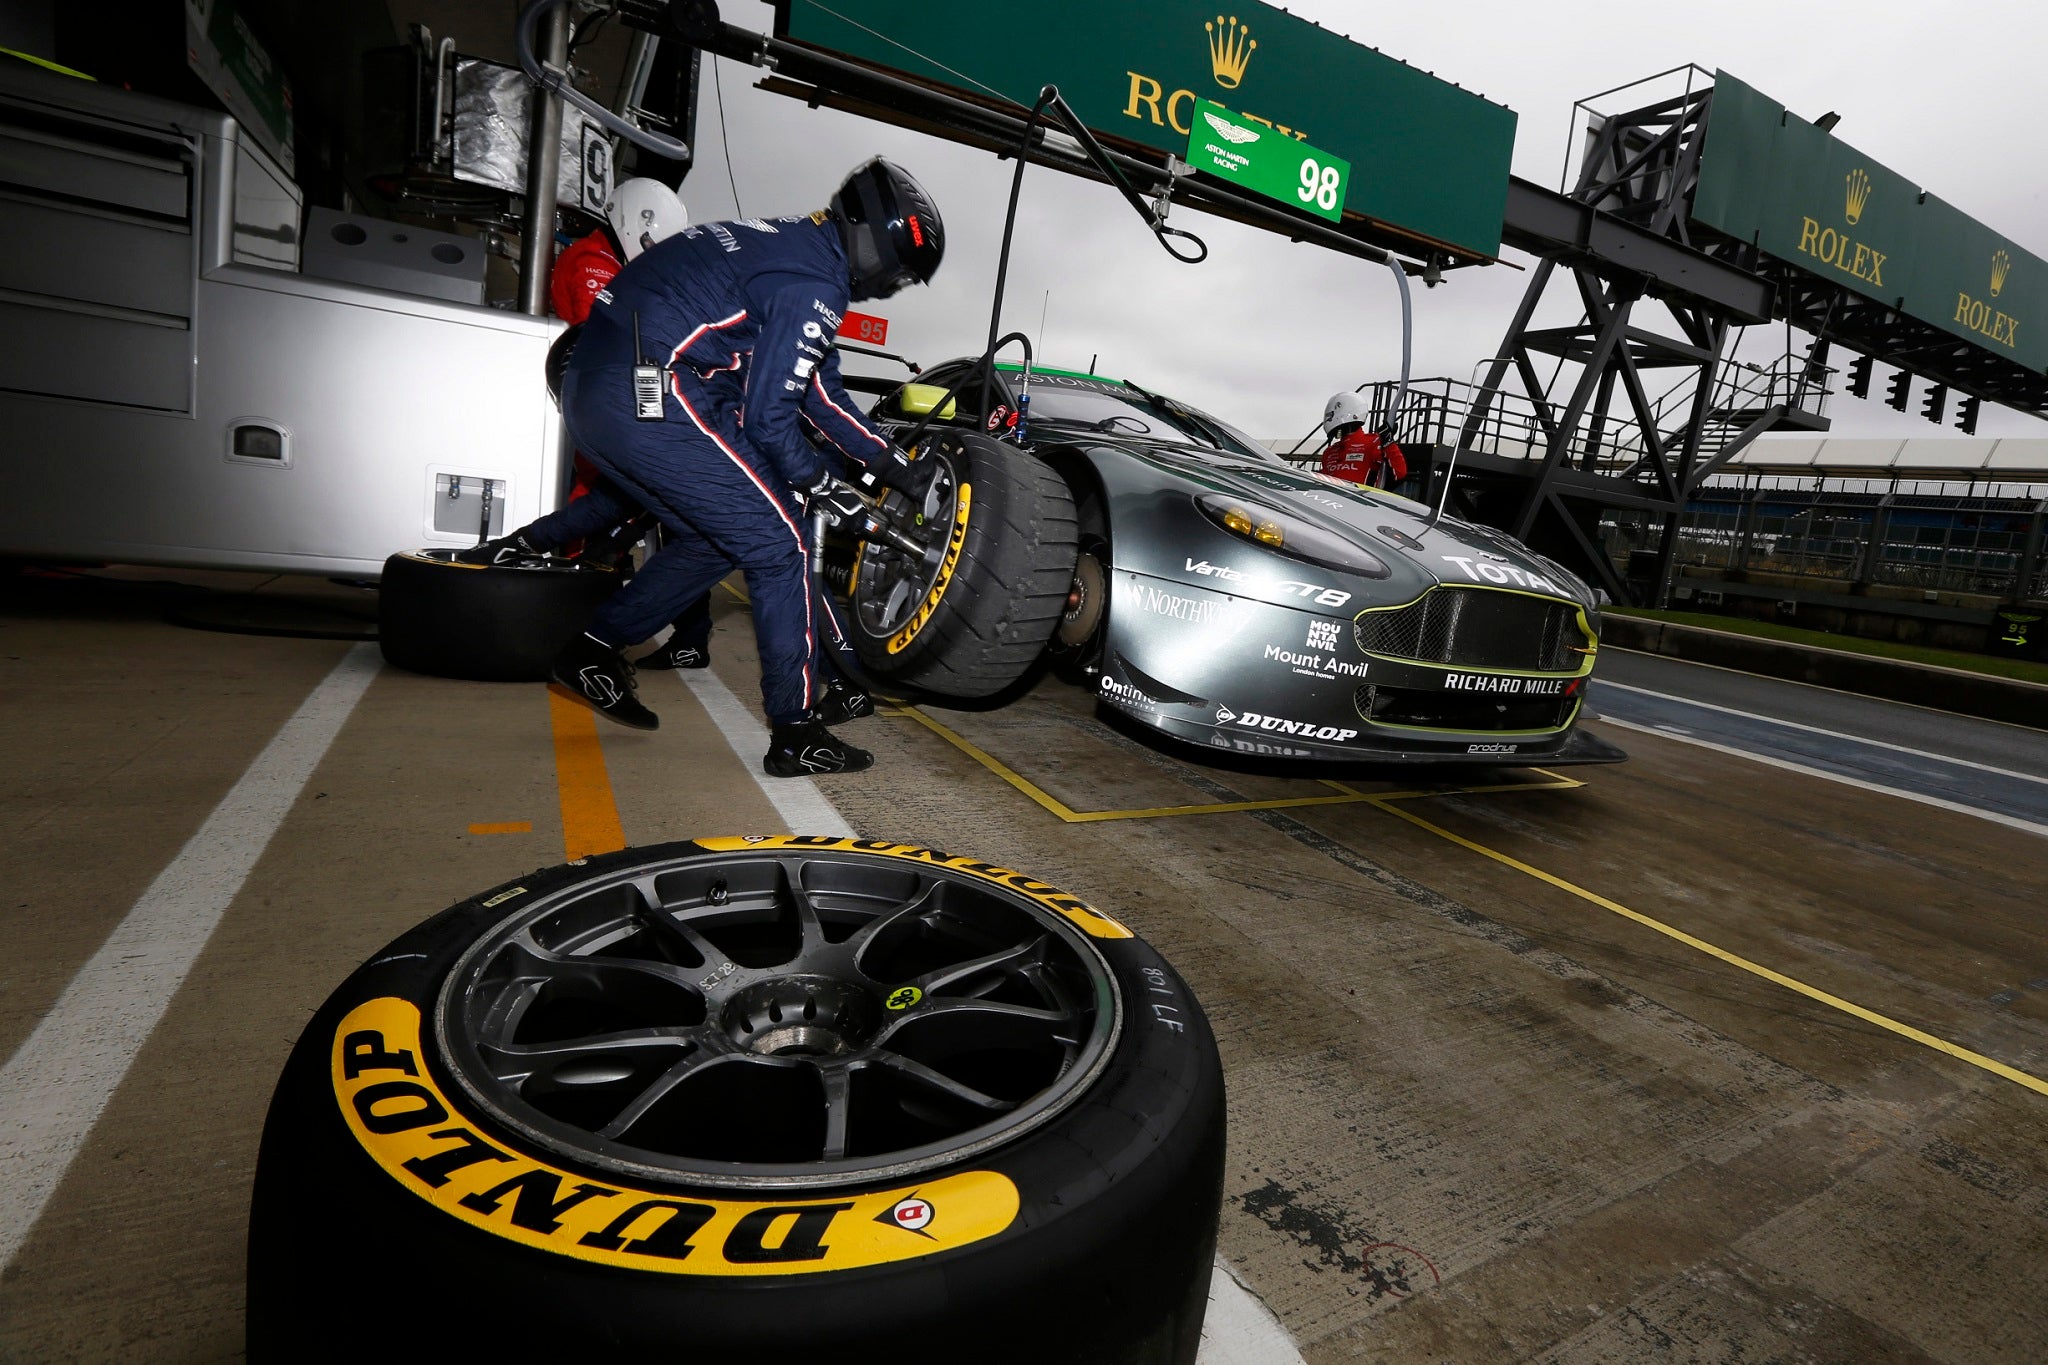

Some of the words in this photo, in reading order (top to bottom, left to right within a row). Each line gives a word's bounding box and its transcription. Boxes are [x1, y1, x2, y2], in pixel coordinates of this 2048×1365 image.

[1205, 143, 1226, 157] ASTON
[1226, 151, 1249, 166] MARTIN
[1213, 156, 1238, 172] RACING
[1297, 158, 1340, 211] 98
[909, 215, 924, 247] uvex
[1798, 216, 1887, 287] ROLEX
[860, 319, 885, 341] 95
[1954, 292, 2019, 348] ROLEX
[1327, 463, 1358, 471] TOTAL
[1441, 555, 1571, 598] TOTAL
[1308, 628, 1338, 643] NTA
[1310, 619, 1341, 634] MOU
[2008, 623, 2028, 634] 95
[1306, 637, 1336, 652] NVIL
[1264, 644, 1321, 669] Mount
[1323, 657, 1369, 678] Anvil
[1292, 666, 1315, 677] London
[1315, 671, 1336, 680] homes
[1444, 673, 1521, 693] RICHARD
[1523, 680, 1563, 694] MILLE
[1099, 690, 1156, 712] AUTOMOTIVE
[1236, 712, 1358, 742] DUNLOP
[1467, 743, 1518, 753] prodrive
[784, 835, 1113, 921] DUNLOP
[343, 1029, 856, 1264] DUNLOP
